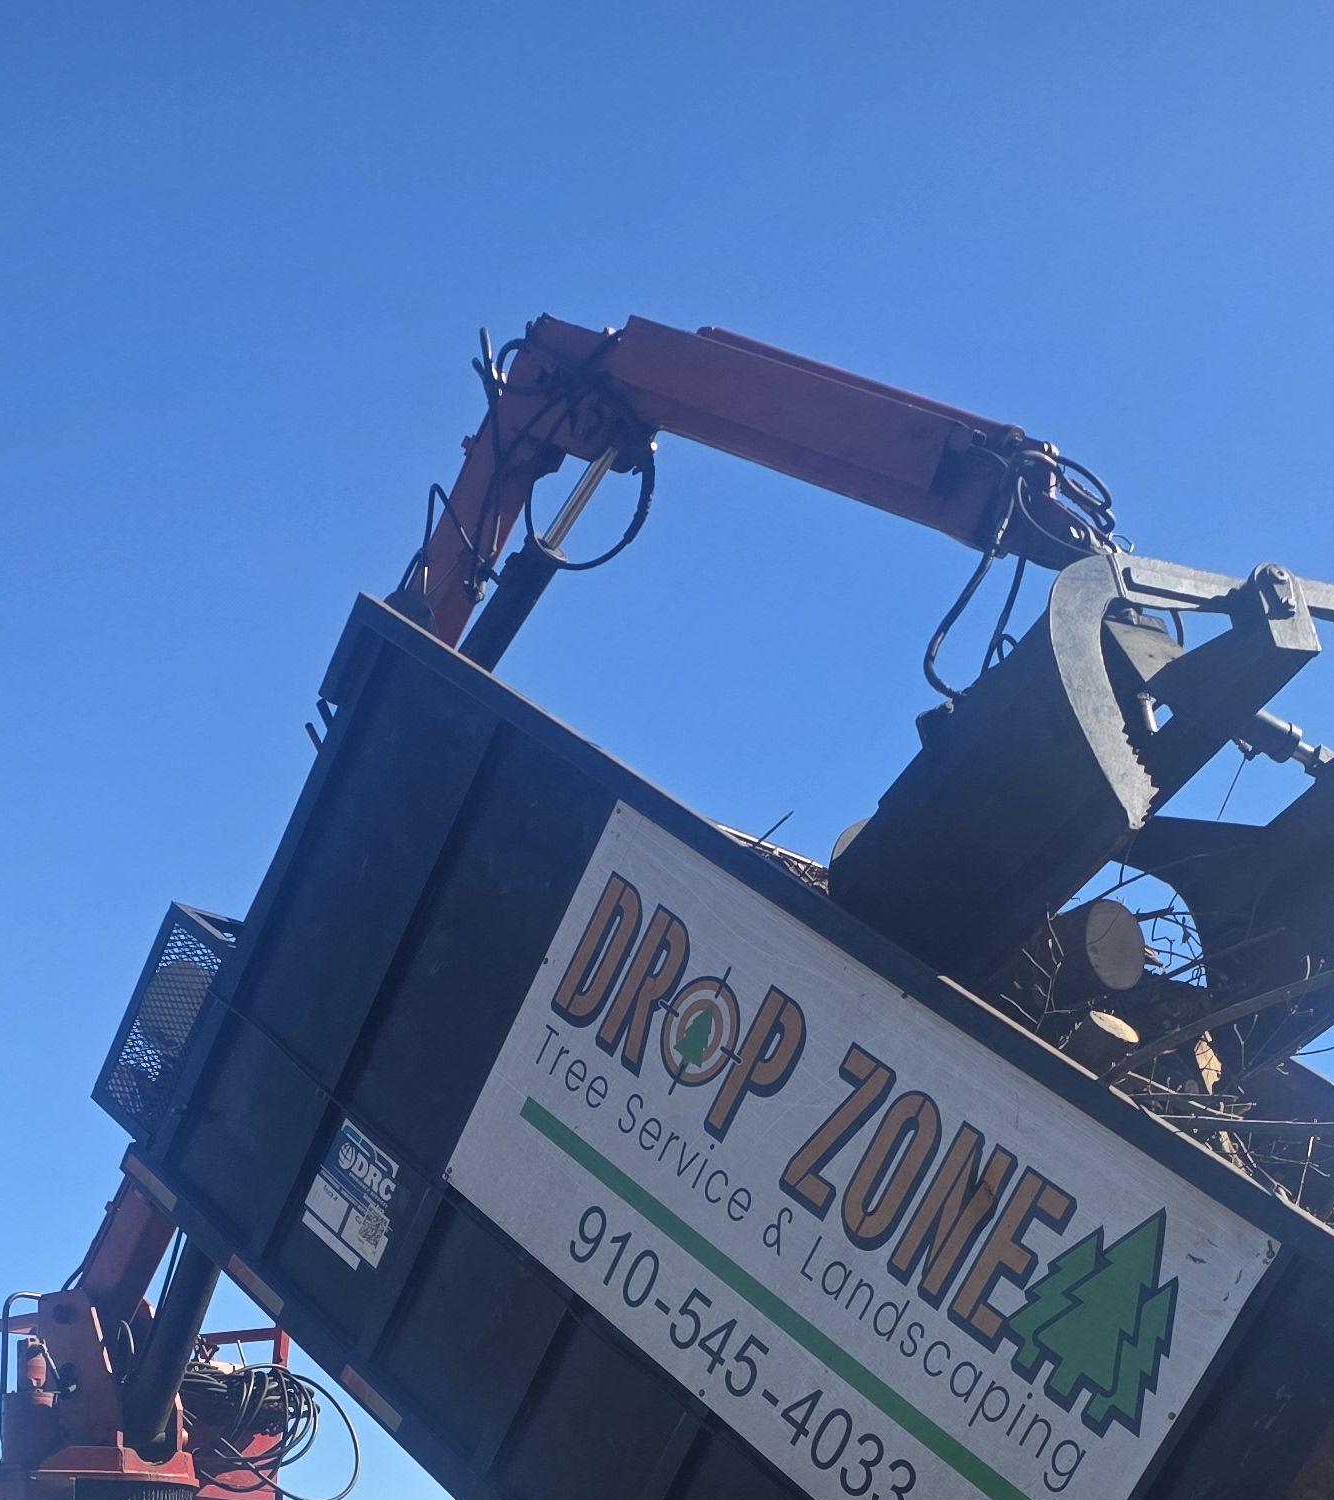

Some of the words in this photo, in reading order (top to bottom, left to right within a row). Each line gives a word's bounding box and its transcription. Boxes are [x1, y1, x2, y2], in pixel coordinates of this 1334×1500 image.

[350, 1152, 397, 1201] DRC
[535, 1023, 609, 1109] Tree
[618, 1093, 752, 1222] Service
[762, 1206, 794, 1257] &
[799, 1235, 1087, 1493] Landscaping
[551, 870, 807, 1144] DROP
[779, 1042, 1078, 1355] ZONE
